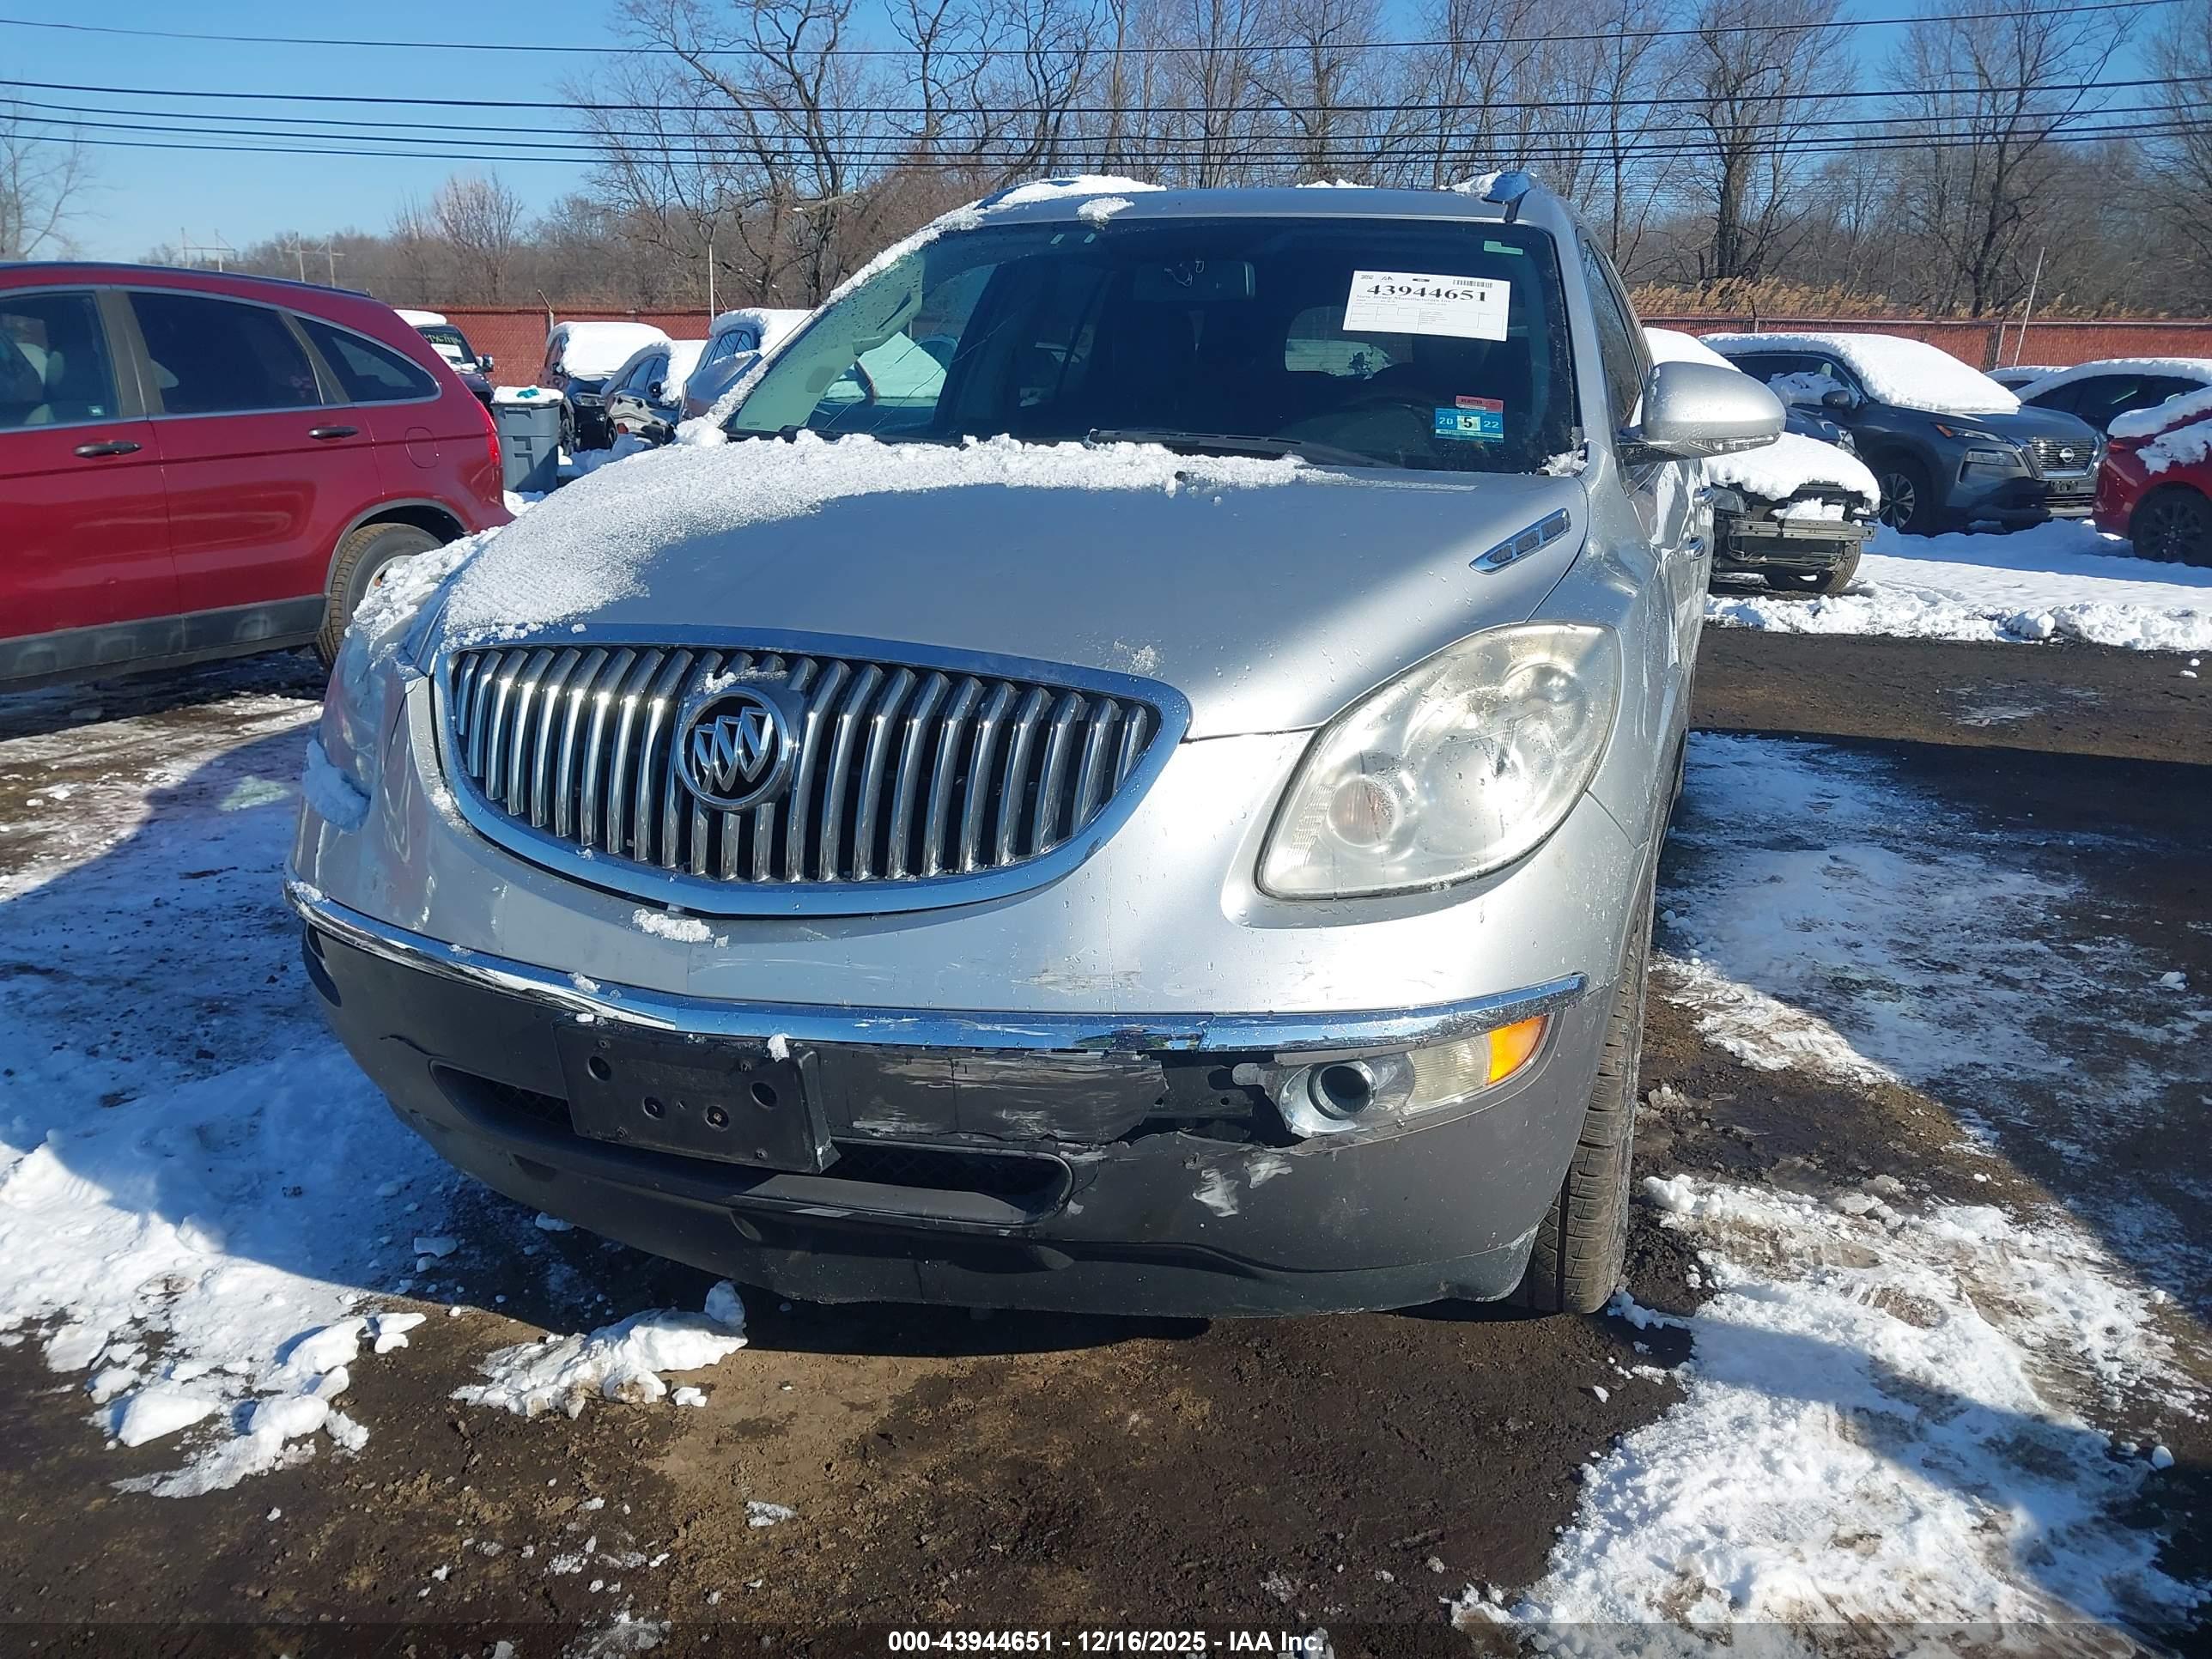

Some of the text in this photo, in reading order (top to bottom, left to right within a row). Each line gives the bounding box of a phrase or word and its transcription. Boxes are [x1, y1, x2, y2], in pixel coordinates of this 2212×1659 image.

[1367, 285, 1488, 302] 43944651
[1438, 416, 1499, 428] 20 5 22
